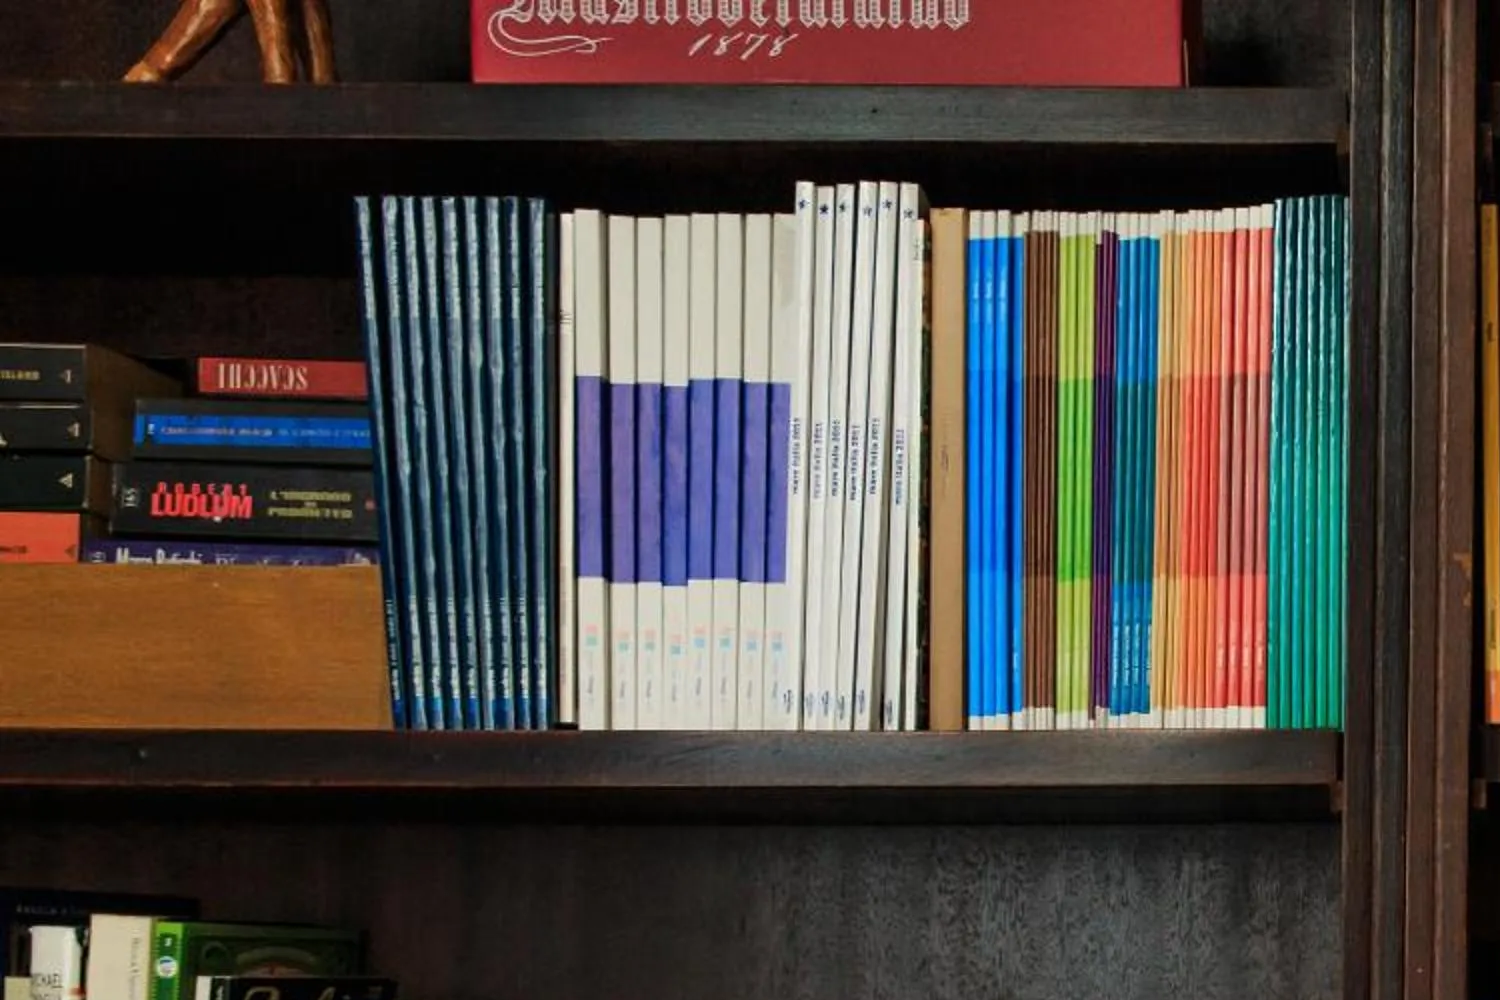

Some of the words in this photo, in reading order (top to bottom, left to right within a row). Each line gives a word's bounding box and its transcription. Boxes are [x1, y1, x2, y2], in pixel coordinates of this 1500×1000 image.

[688, 33, 798, 60] 1878
[217, 363, 309, 391] SCACCHI
[150, 492, 253, 519] LUDLUM
